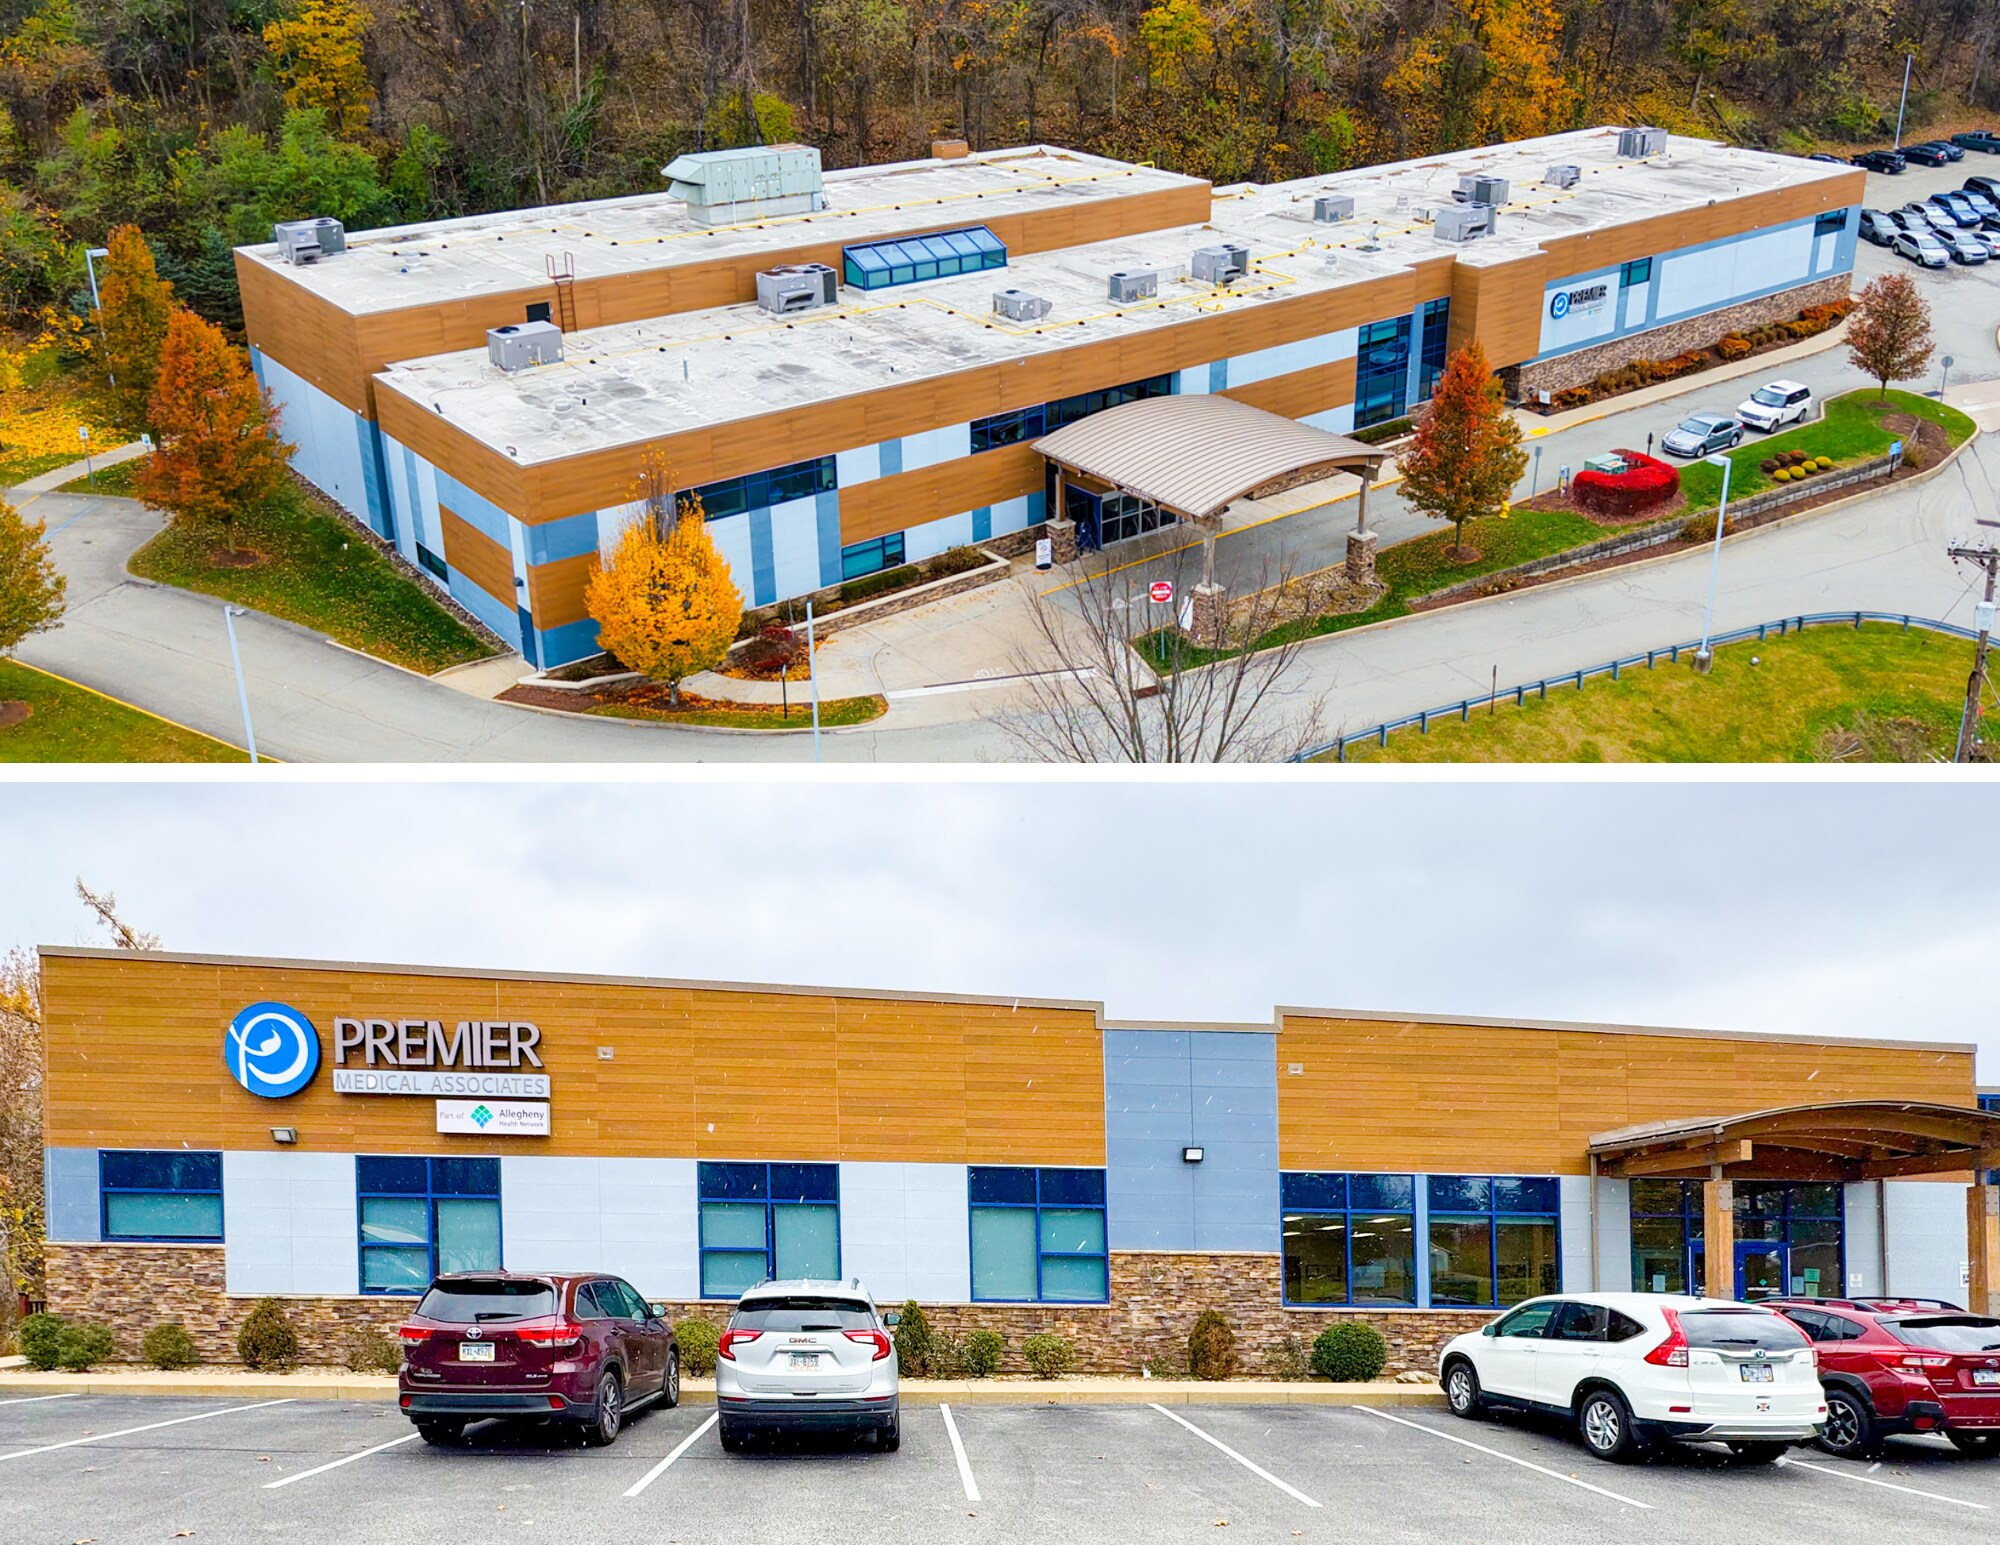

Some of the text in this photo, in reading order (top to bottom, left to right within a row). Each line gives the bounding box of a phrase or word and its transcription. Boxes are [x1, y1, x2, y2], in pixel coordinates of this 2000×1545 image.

[334, 1018, 544, 1068] PREMIER
[336, 1073, 545, 1095] MEDICAL ASSOCIATES
[440, 1111, 465, 1120] Part of
[499, 1109, 545, 1120] Allegheny
